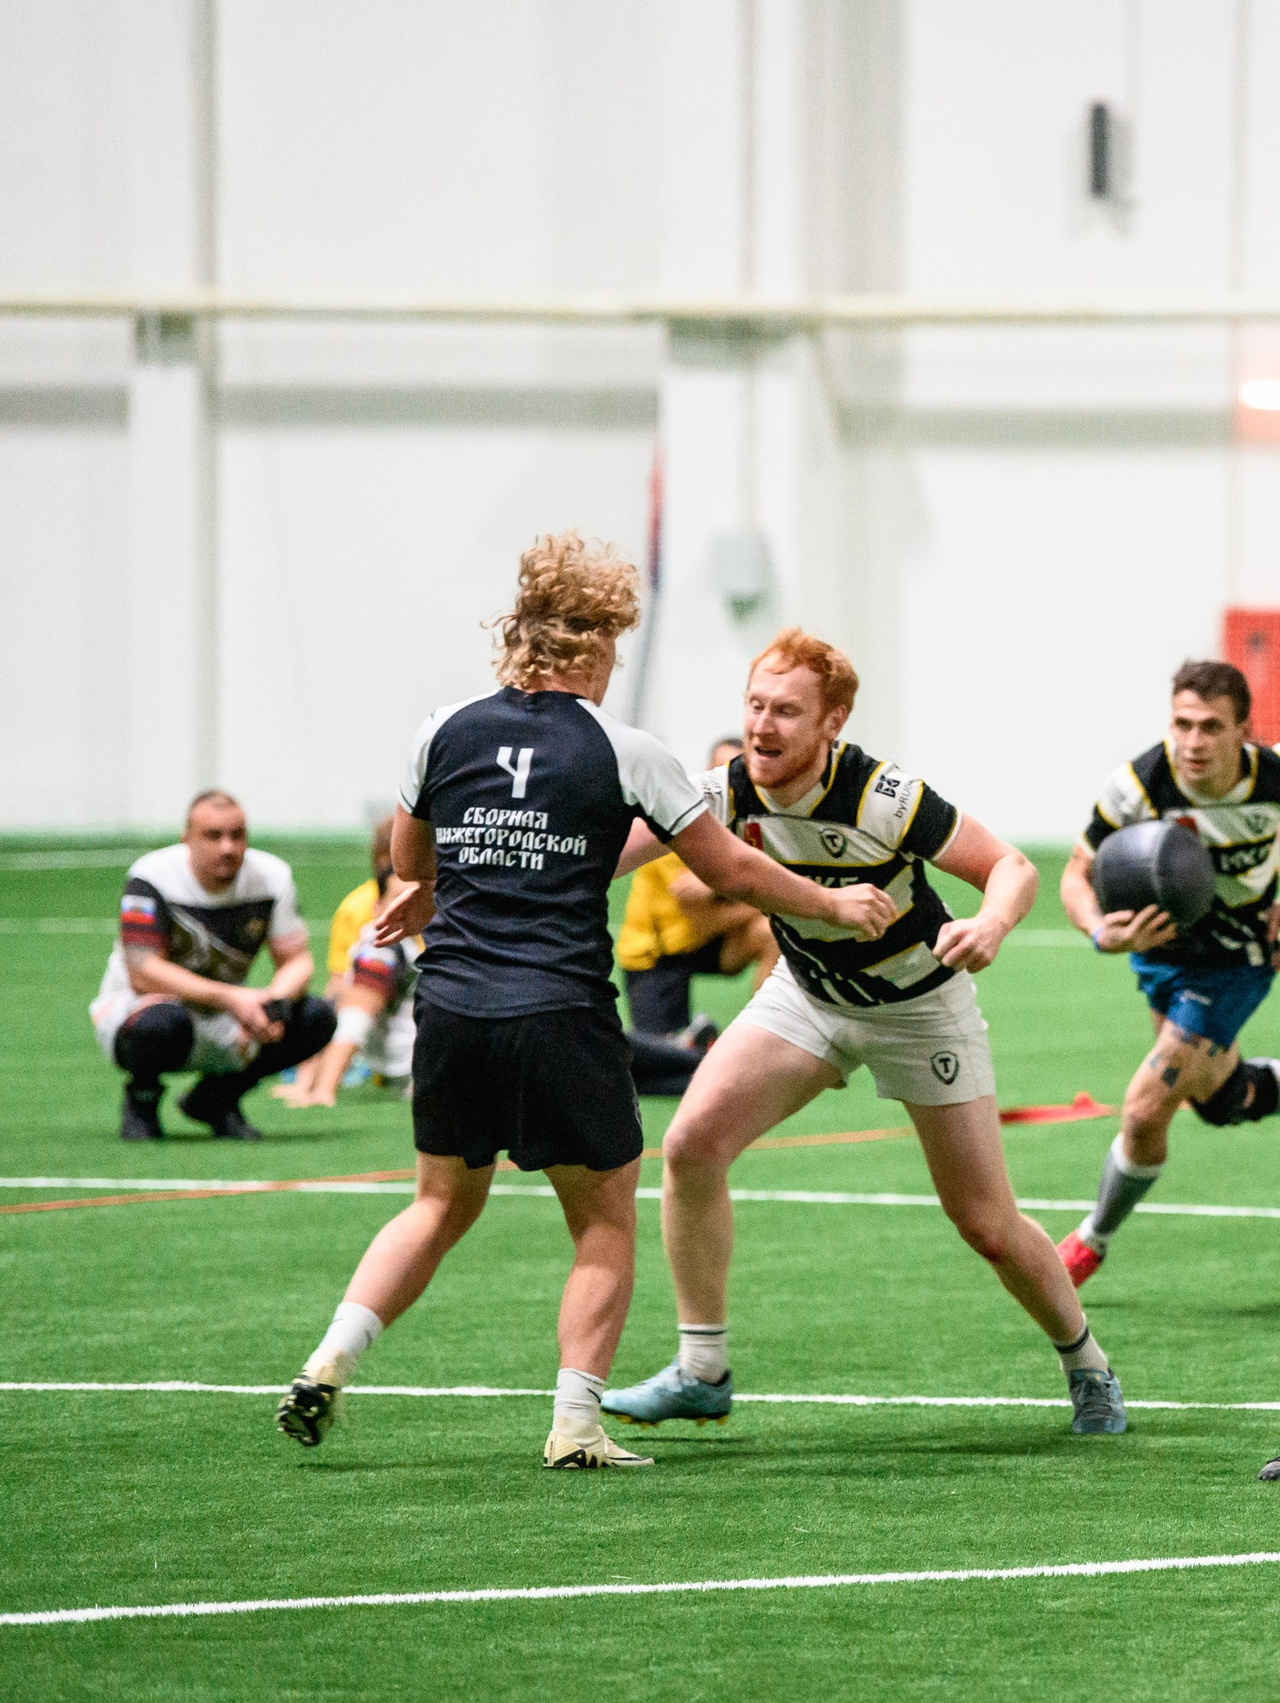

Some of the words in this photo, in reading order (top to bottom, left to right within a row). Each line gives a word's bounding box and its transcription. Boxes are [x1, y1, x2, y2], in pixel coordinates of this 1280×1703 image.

[462, 806, 549, 830] СБОРНАЯ
[435, 827, 588, 856] НИЖЕГОРОДСКОЙ
[458, 846, 544, 871] ОБЛАСТИ
